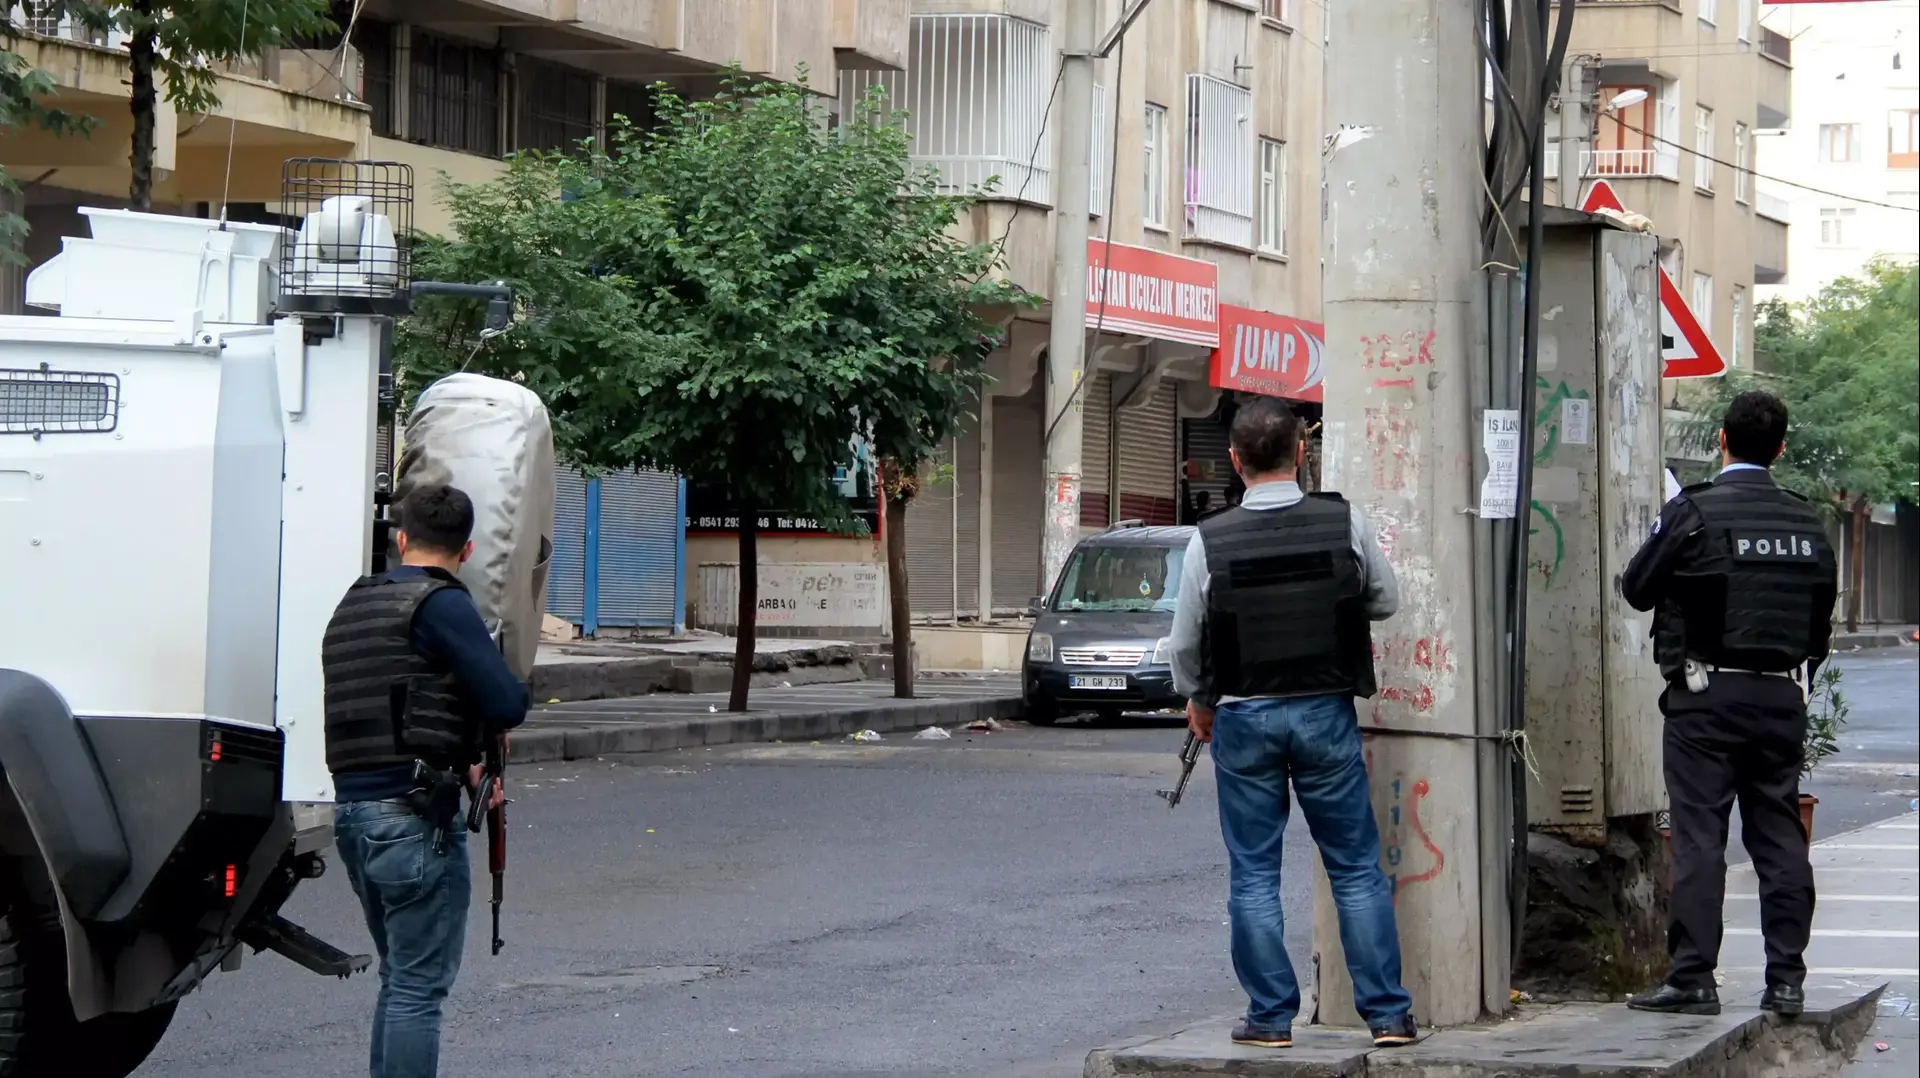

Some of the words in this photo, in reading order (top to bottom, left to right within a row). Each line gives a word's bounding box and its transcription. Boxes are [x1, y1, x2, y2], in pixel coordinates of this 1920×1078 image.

[1129, 272, 1174, 316] UCUZLUK
[1175, 280, 1216, 323] MERKEZİ
[1230, 323, 1296, 378] JUMP
[700, 516, 721, 527] 0541
[777, 517, 793, 528] Tel:
[1737, 535, 1812, 556] POLİS
[1076, 677, 1086, 687] 21
[1092, 677, 1103, 687] GH
[1108, 677, 1124, 687] 233
